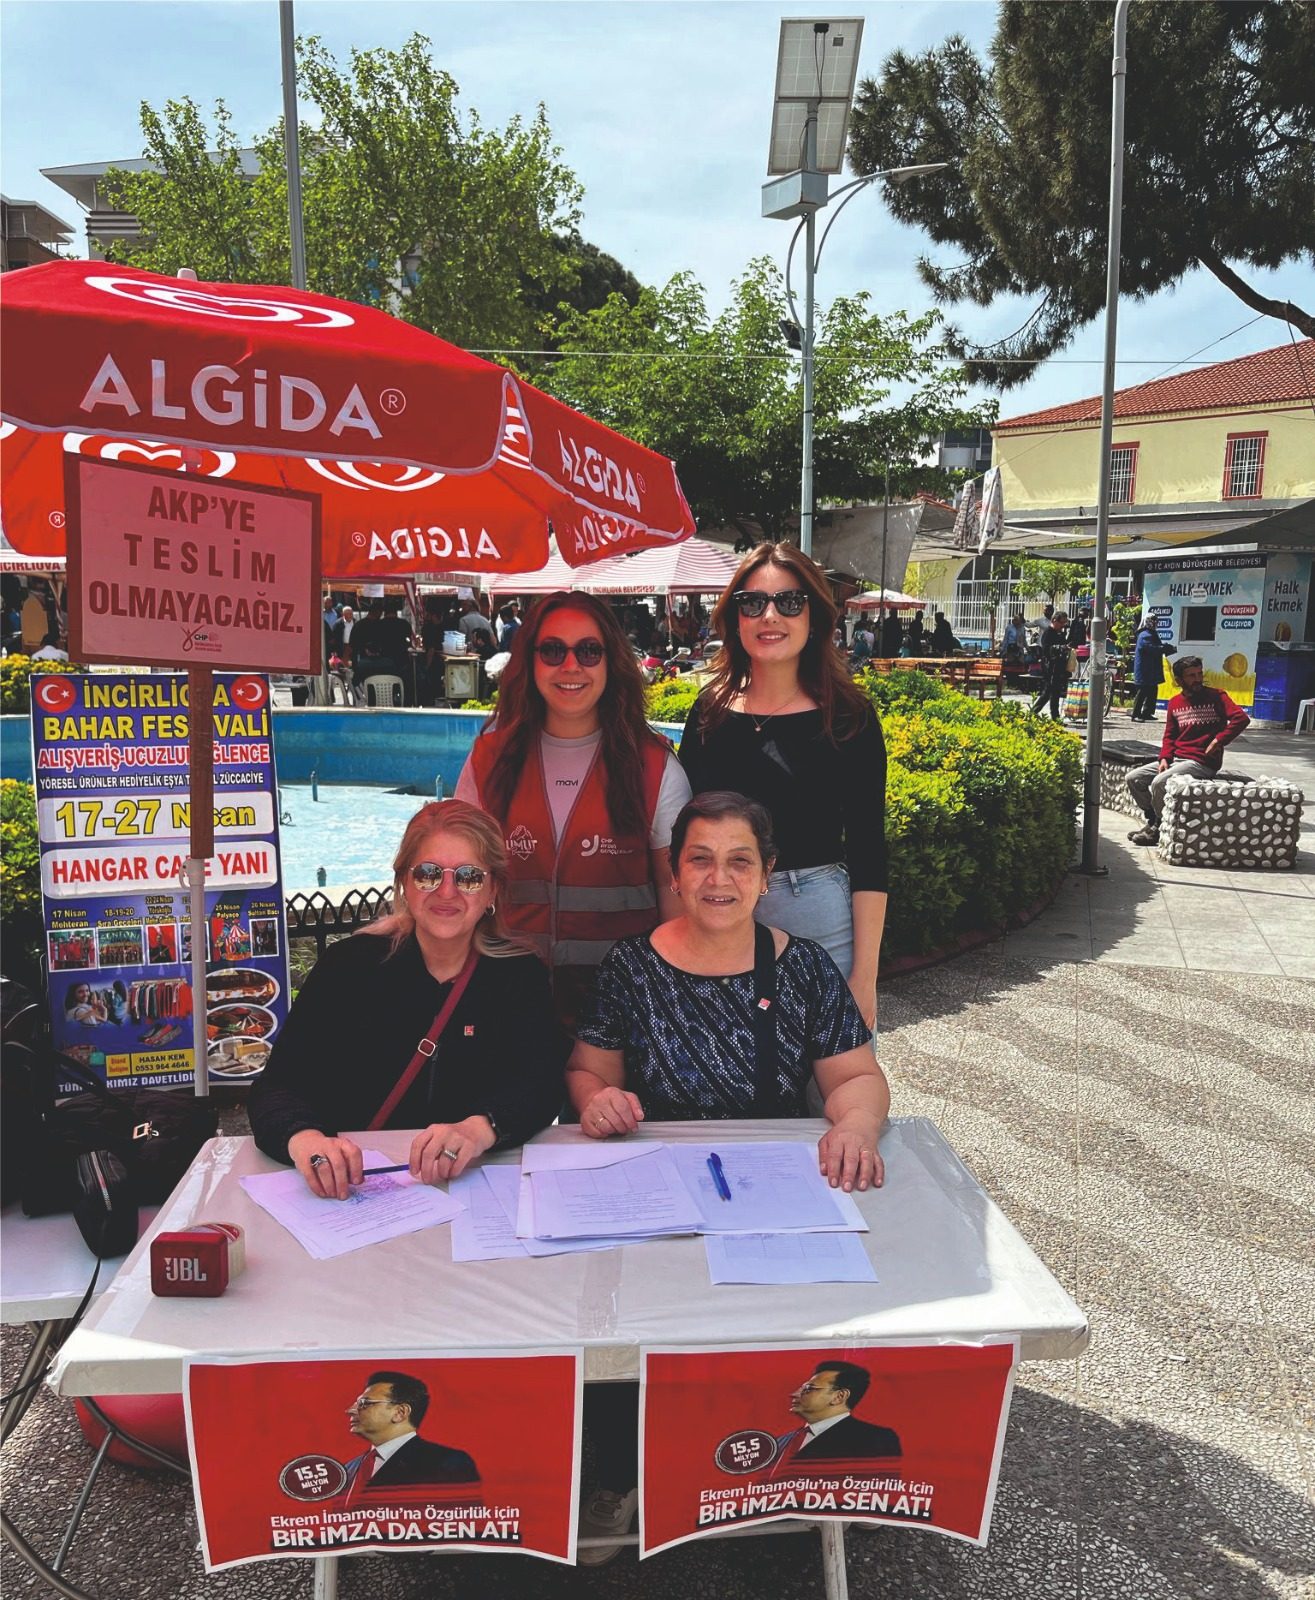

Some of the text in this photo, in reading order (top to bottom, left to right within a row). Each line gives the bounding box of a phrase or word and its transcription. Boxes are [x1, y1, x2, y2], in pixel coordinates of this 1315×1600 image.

[1182, 558, 1223, 569] BÜYÜKŞEHİR
[1225, 557, 1261, 566] BELEDİYESİ
[1169, 583, 1194, 597] HALK
[1274, 580, 1299, 595] Halk
[89, 580, 303, 634] OLMAYACAĞIZ.
[1223, 606, 1255, 615] BÜYÜKŞEHİR
[1267, 598, 1303, 613] Ekmek
[1223, 620, 1252, 629] ÇALIŞIYOR
[83, 679, 230, 709] İNCİRLİA
[43, 708, 269, 741] BAHAR FESVALİ
[38, 742, 270, 773] ALIŞVERİŞ-UCUZLUĞLENCE
[40, 777, 78, 790] YÖRESEL
[79, 775, 118, 788] ÜRÜNLER
[119, 773, 162, 787] HEDİYELİK
[163, 774, 183, 788] EŞYA
[219, 771, 264, 785] ZÜCCACİYE
[555, 779, 579, 787] mavi
[56, 799, 256, 838] 17-27 Nsan
[505, 840, 539, 851] UMUT
[52, 851, 268, 884] HANGAR CAE YANI
[64, 910, 87, 918] Nisan
[139, 1055, 166, 1063] HASAN
[164, 1257, 207, 1282] JBL
[742, 1459, 753, 1467] OY
[311, 1486, 322, 1494] OY
[700, 1487, 744, 1503] Ekrem
[842, 1475, 906, 1492] Özgürlük
[909, 1481, 934, 1496] için
[803, 1493, 838, 1510] DA
[841, 1492, 890, 1512] SEN
[892, 1496, 932, 1517] AT!
[271, 1515, 320, 1528] Ekrem
[424, 1504, 495, 1523] Özgürlük
[494, 1506, 520, 1521] için
[388, 1522, 424, 1540] DA
[427, 1523, 476, 1540] SEN
[481, 1520, 520, 1540] AT!
